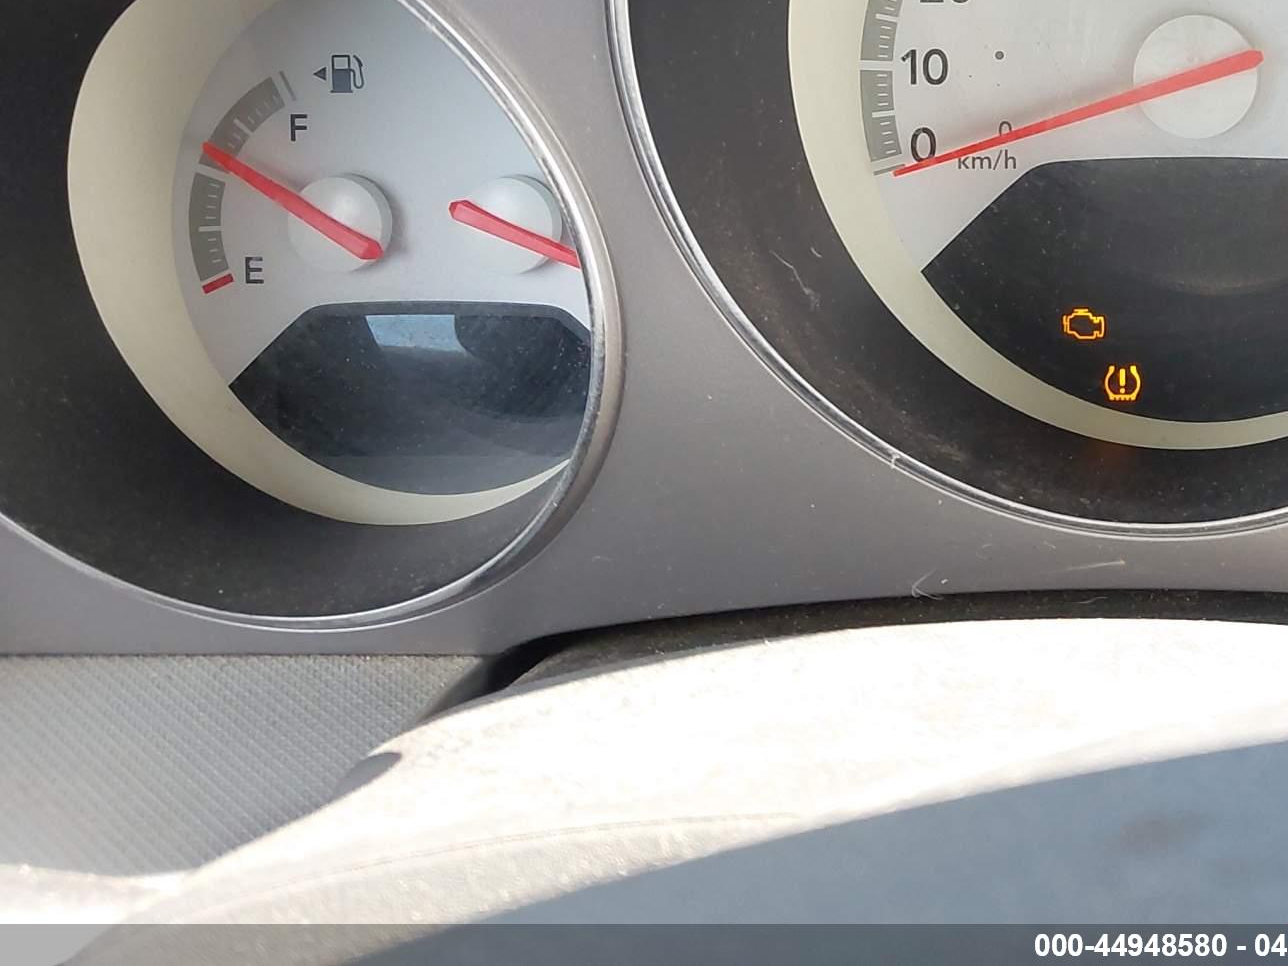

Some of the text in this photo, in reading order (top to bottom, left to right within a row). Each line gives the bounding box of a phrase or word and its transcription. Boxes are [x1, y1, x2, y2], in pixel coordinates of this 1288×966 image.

[901, 48, 949, 85] 10
[290, 114, 308, 141] F
[910, 127, 936, 163] 0
[957, 149, 1017, 171] km/h
[245, 256, 264, 284] E
